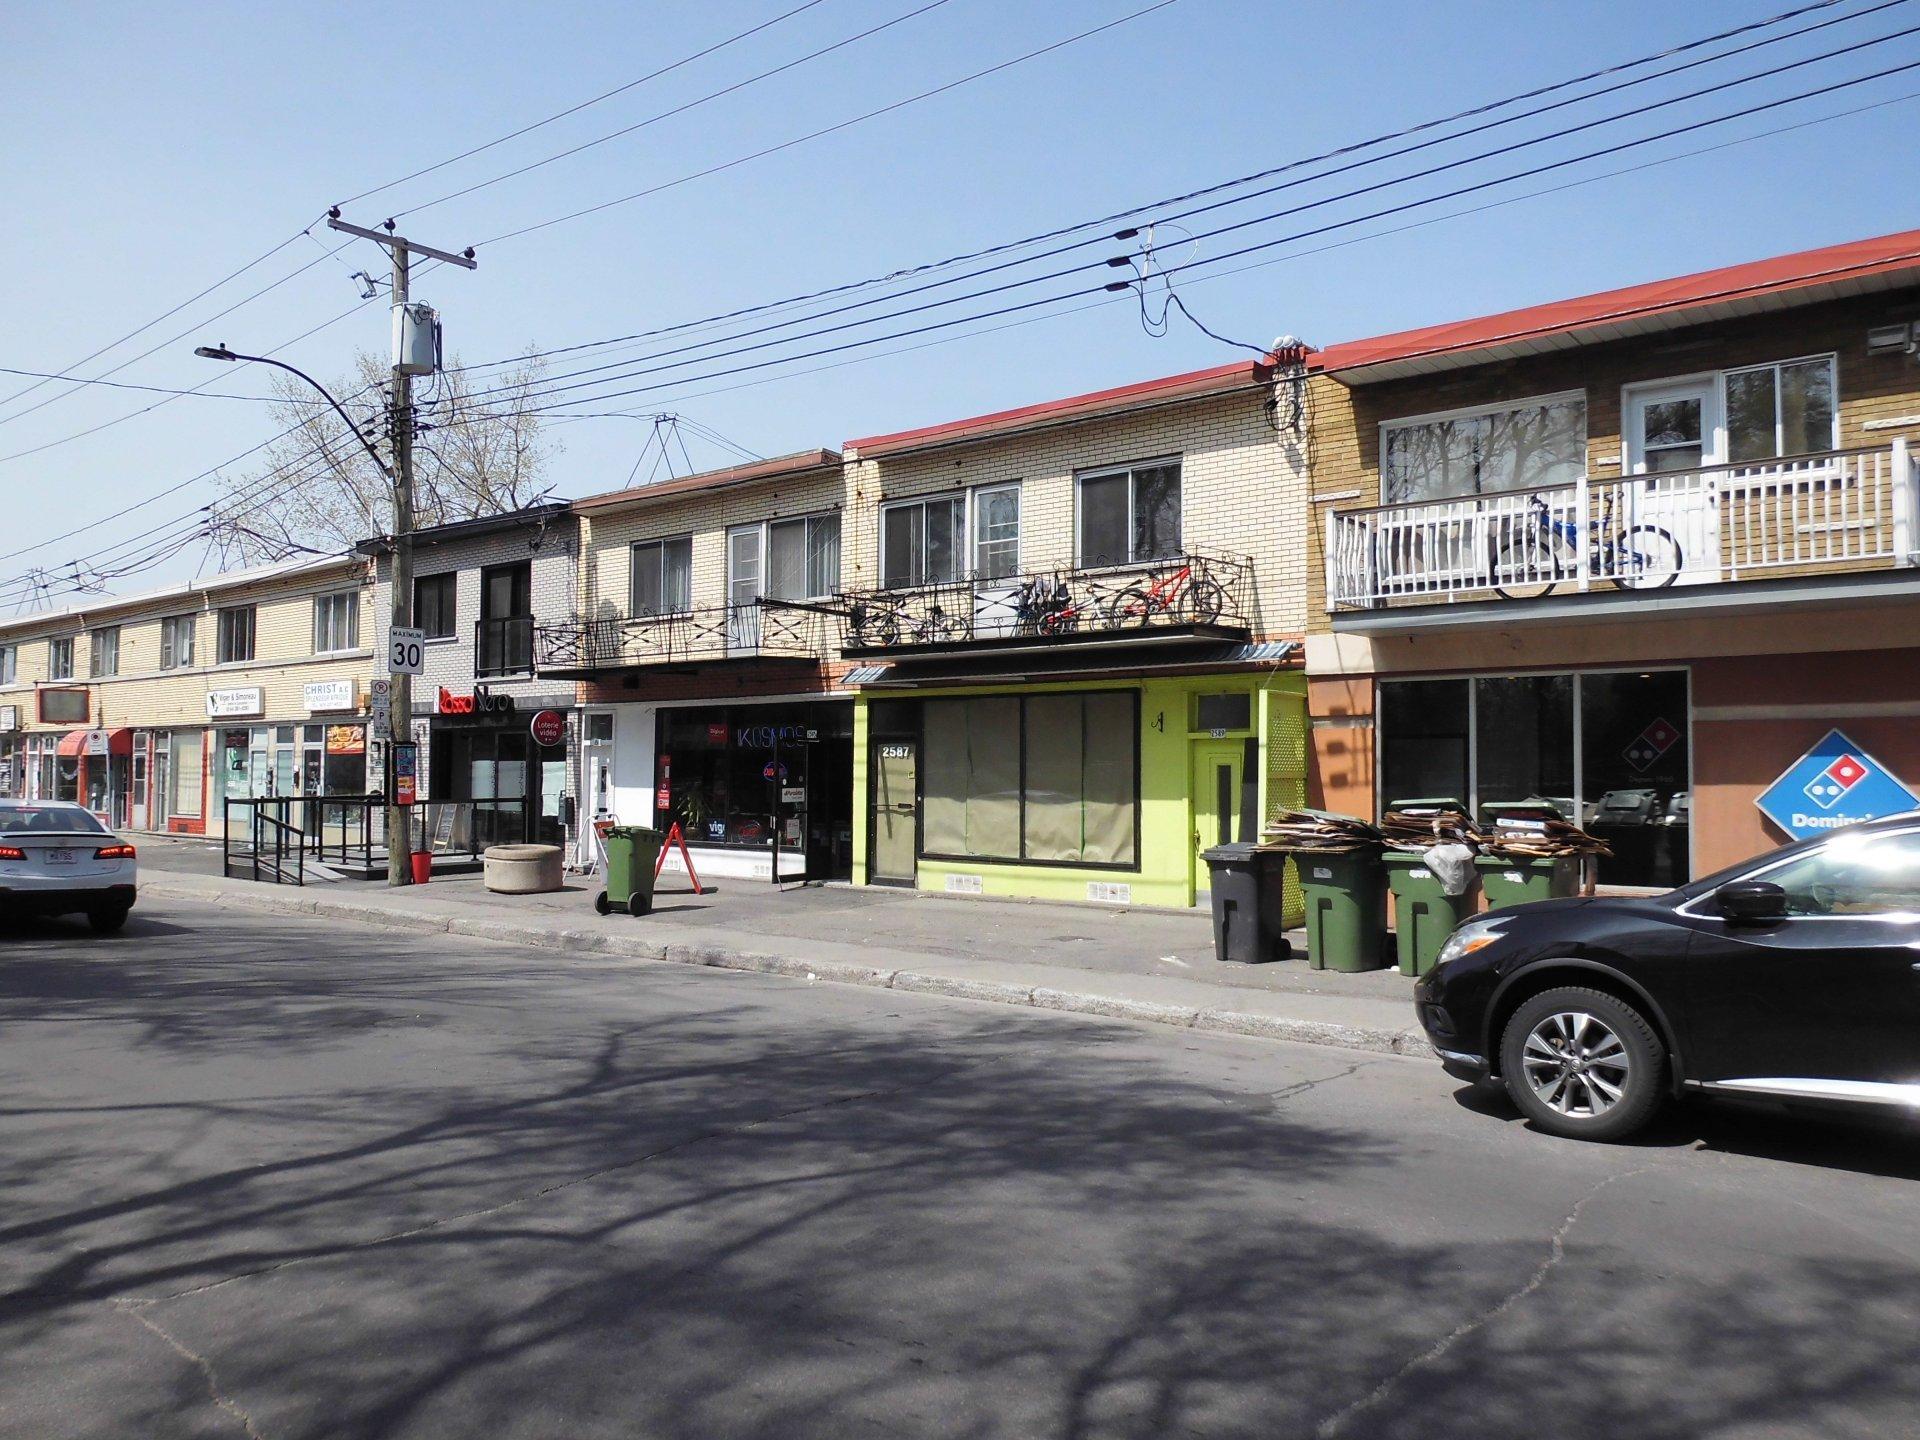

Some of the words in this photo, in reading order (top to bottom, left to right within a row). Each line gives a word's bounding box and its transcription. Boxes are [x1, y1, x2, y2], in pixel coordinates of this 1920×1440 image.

[393, 630, 422, 639] MAXIMUM
[393, 642, 420, 667] 30
[305, 683, 337, 695] CHRIST
[537, 721, 559, 730] Loterie
[539, 729, 557, 737] vidéo
[738, 725, 805, 748] KOSMOS
[882, 746, 910, 758] 2587
